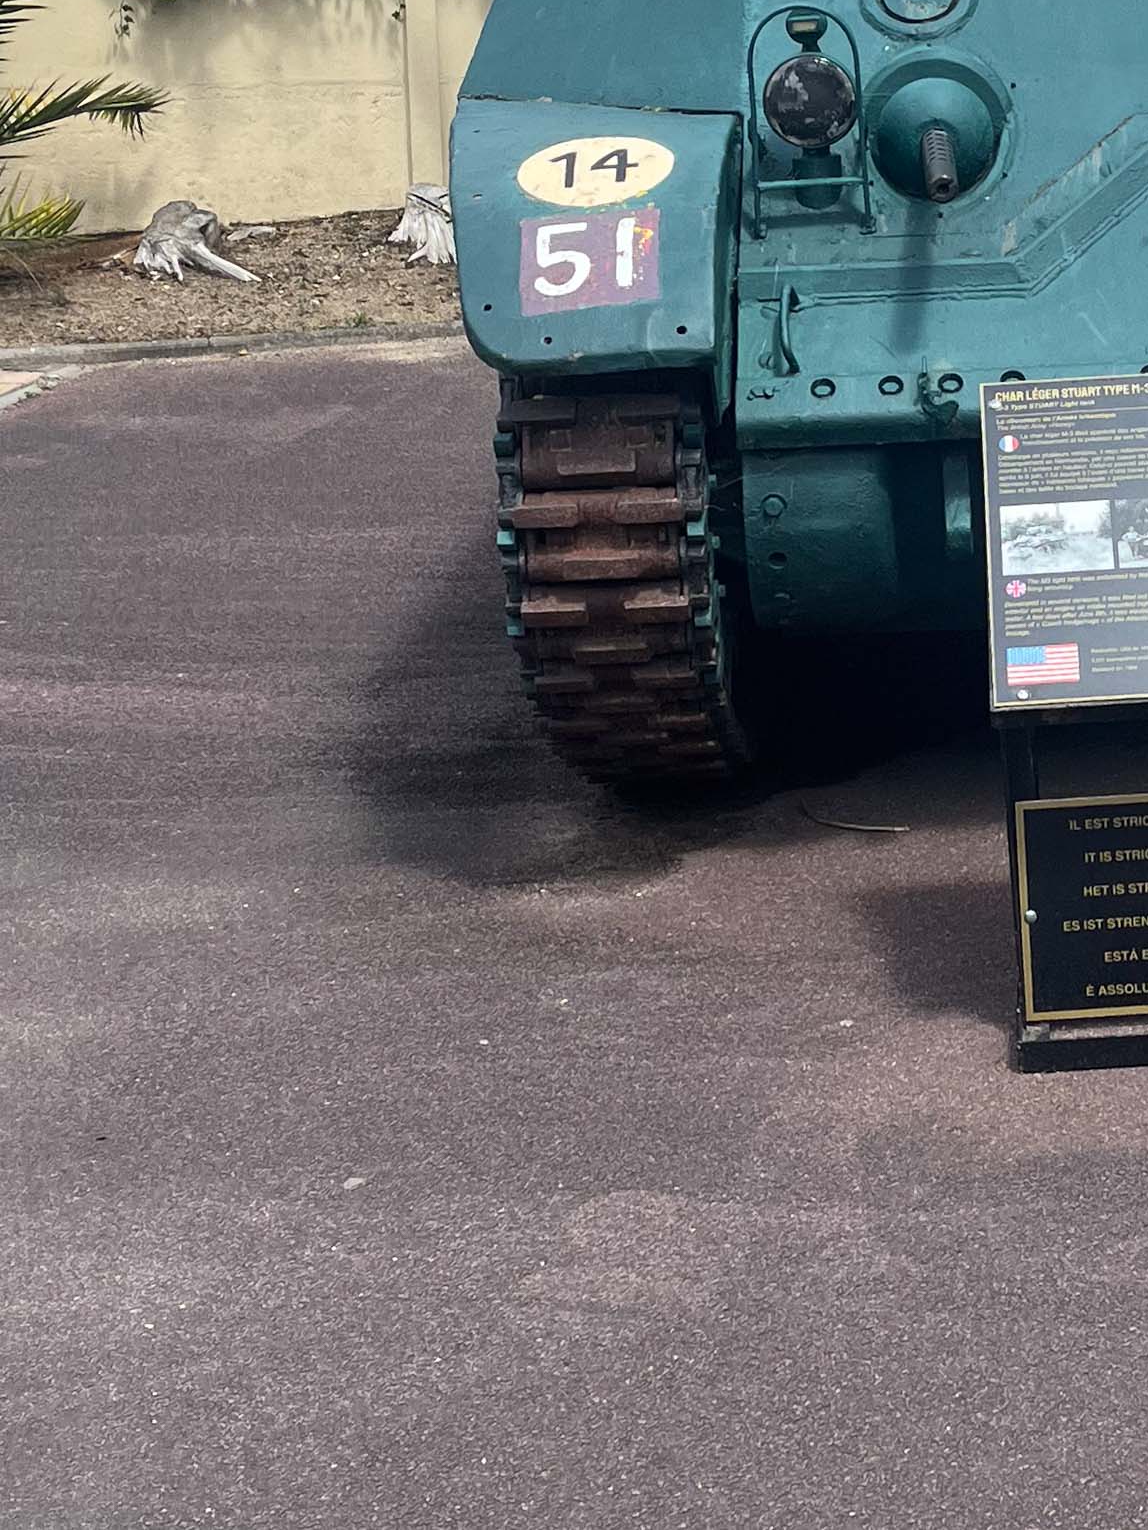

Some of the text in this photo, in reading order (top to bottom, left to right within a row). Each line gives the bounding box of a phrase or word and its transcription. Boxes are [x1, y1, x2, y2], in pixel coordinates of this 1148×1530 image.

[548, 148, 640, 188] 14
[533, 216, 636, 298] 51
[995, 390, 1024, 402] CHAR
[1026, 387, 1059, 401] LÉGER
[1061, 385, 1101, 399] STUART
[1103, 384, 1130, 396] TYPE
[1069, 820, 1080, 830] IL
[1085, 818, 1109, 829] EST
[1085, 852, 1096, 862] IT
[1099, 851, 1112, 862] IS
[1083, 885, 1109, 896] HET
[1112, 883, 1124, 894] IS
[1063, 920, 1080, 931] ES
[1083, 918, 1103, 930] IST
